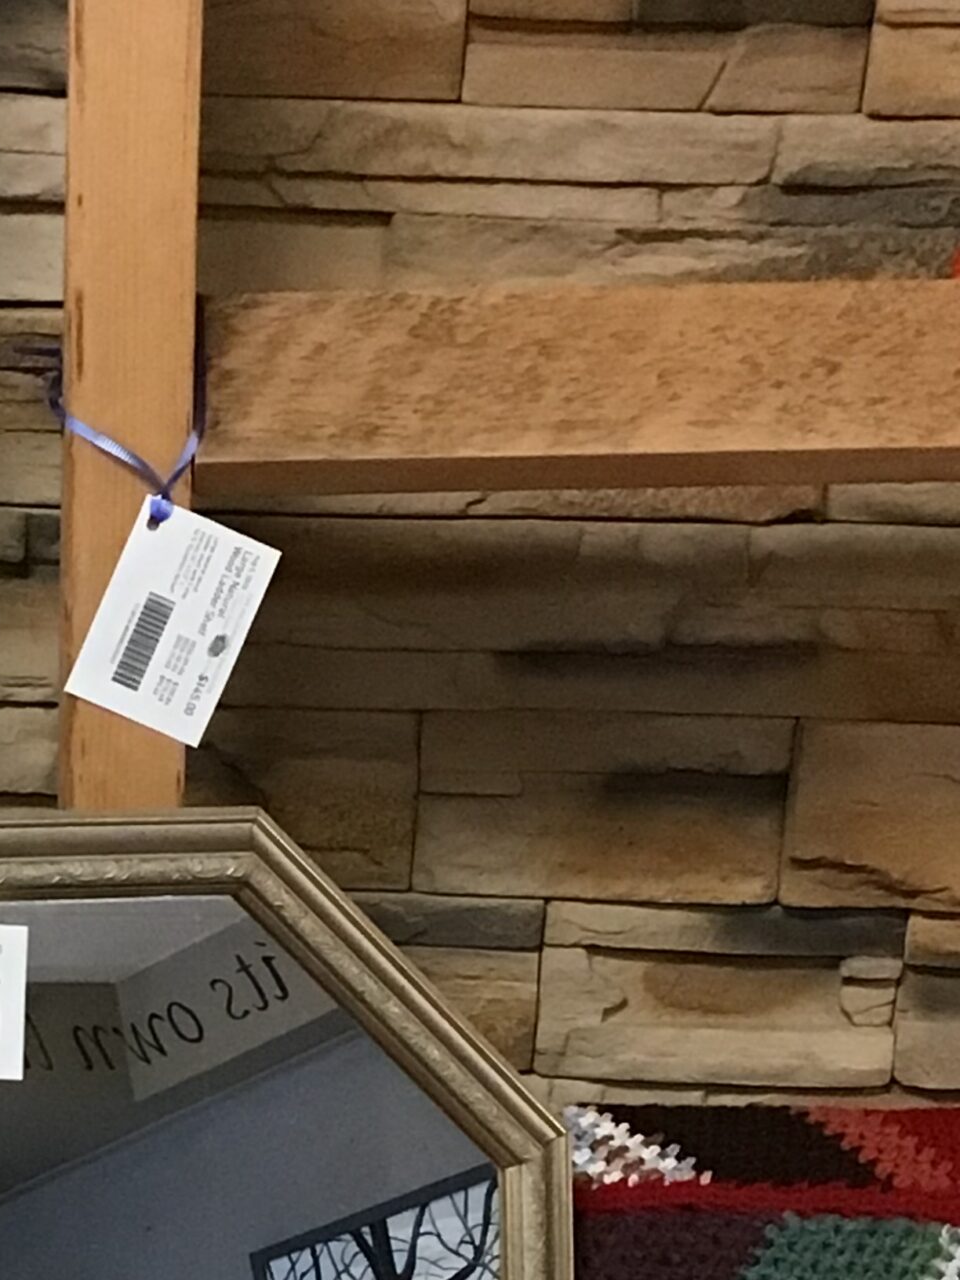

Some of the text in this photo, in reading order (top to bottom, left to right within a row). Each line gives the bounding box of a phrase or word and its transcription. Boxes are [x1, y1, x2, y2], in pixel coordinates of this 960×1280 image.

[224, 544, 243, 573] Wood
[232, 549, 252, 579] Large
[208, 573, 230, 609] Ladder
[216, 580, 240, 619] Natural
[182, 672, 209, 717] $145.00
